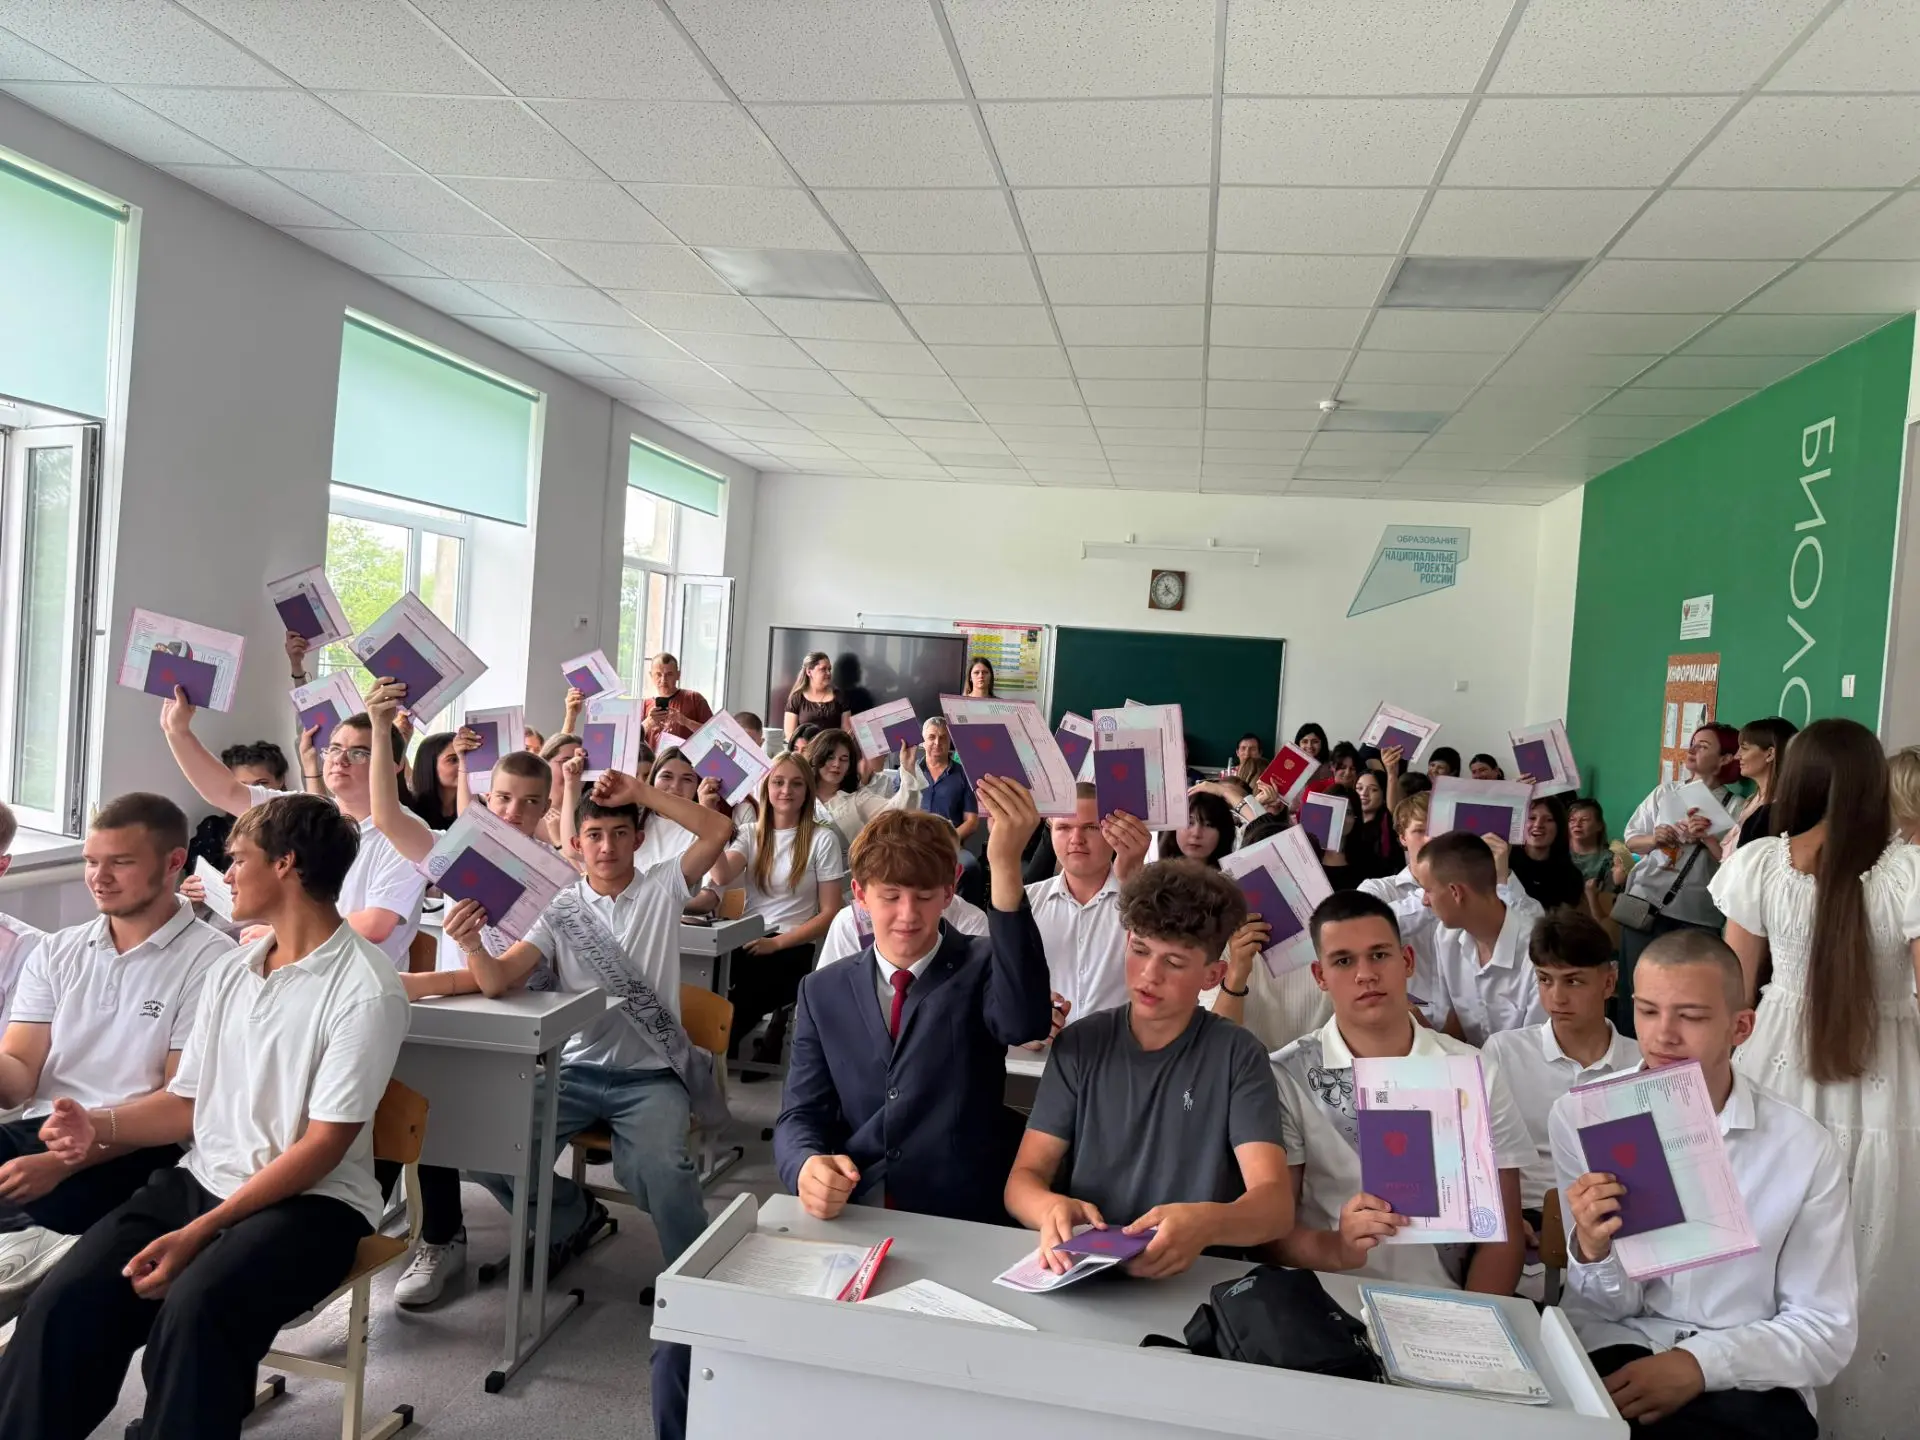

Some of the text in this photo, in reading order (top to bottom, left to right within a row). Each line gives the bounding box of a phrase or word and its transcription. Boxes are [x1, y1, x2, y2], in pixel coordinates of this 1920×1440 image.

[1397, 535, 1458, 545] ОБРАЗОВАНИЕ
[1385, 550, 1454, 562] НАЦИОНАЛЬНЫЕ
[1413, 562, 1454, 573] ПРОЕКТЫ
[1420, 573, 1453, 584] РОССИИ
[1667, 663, 1718, 685] ИНФОРМАЦИЯ
